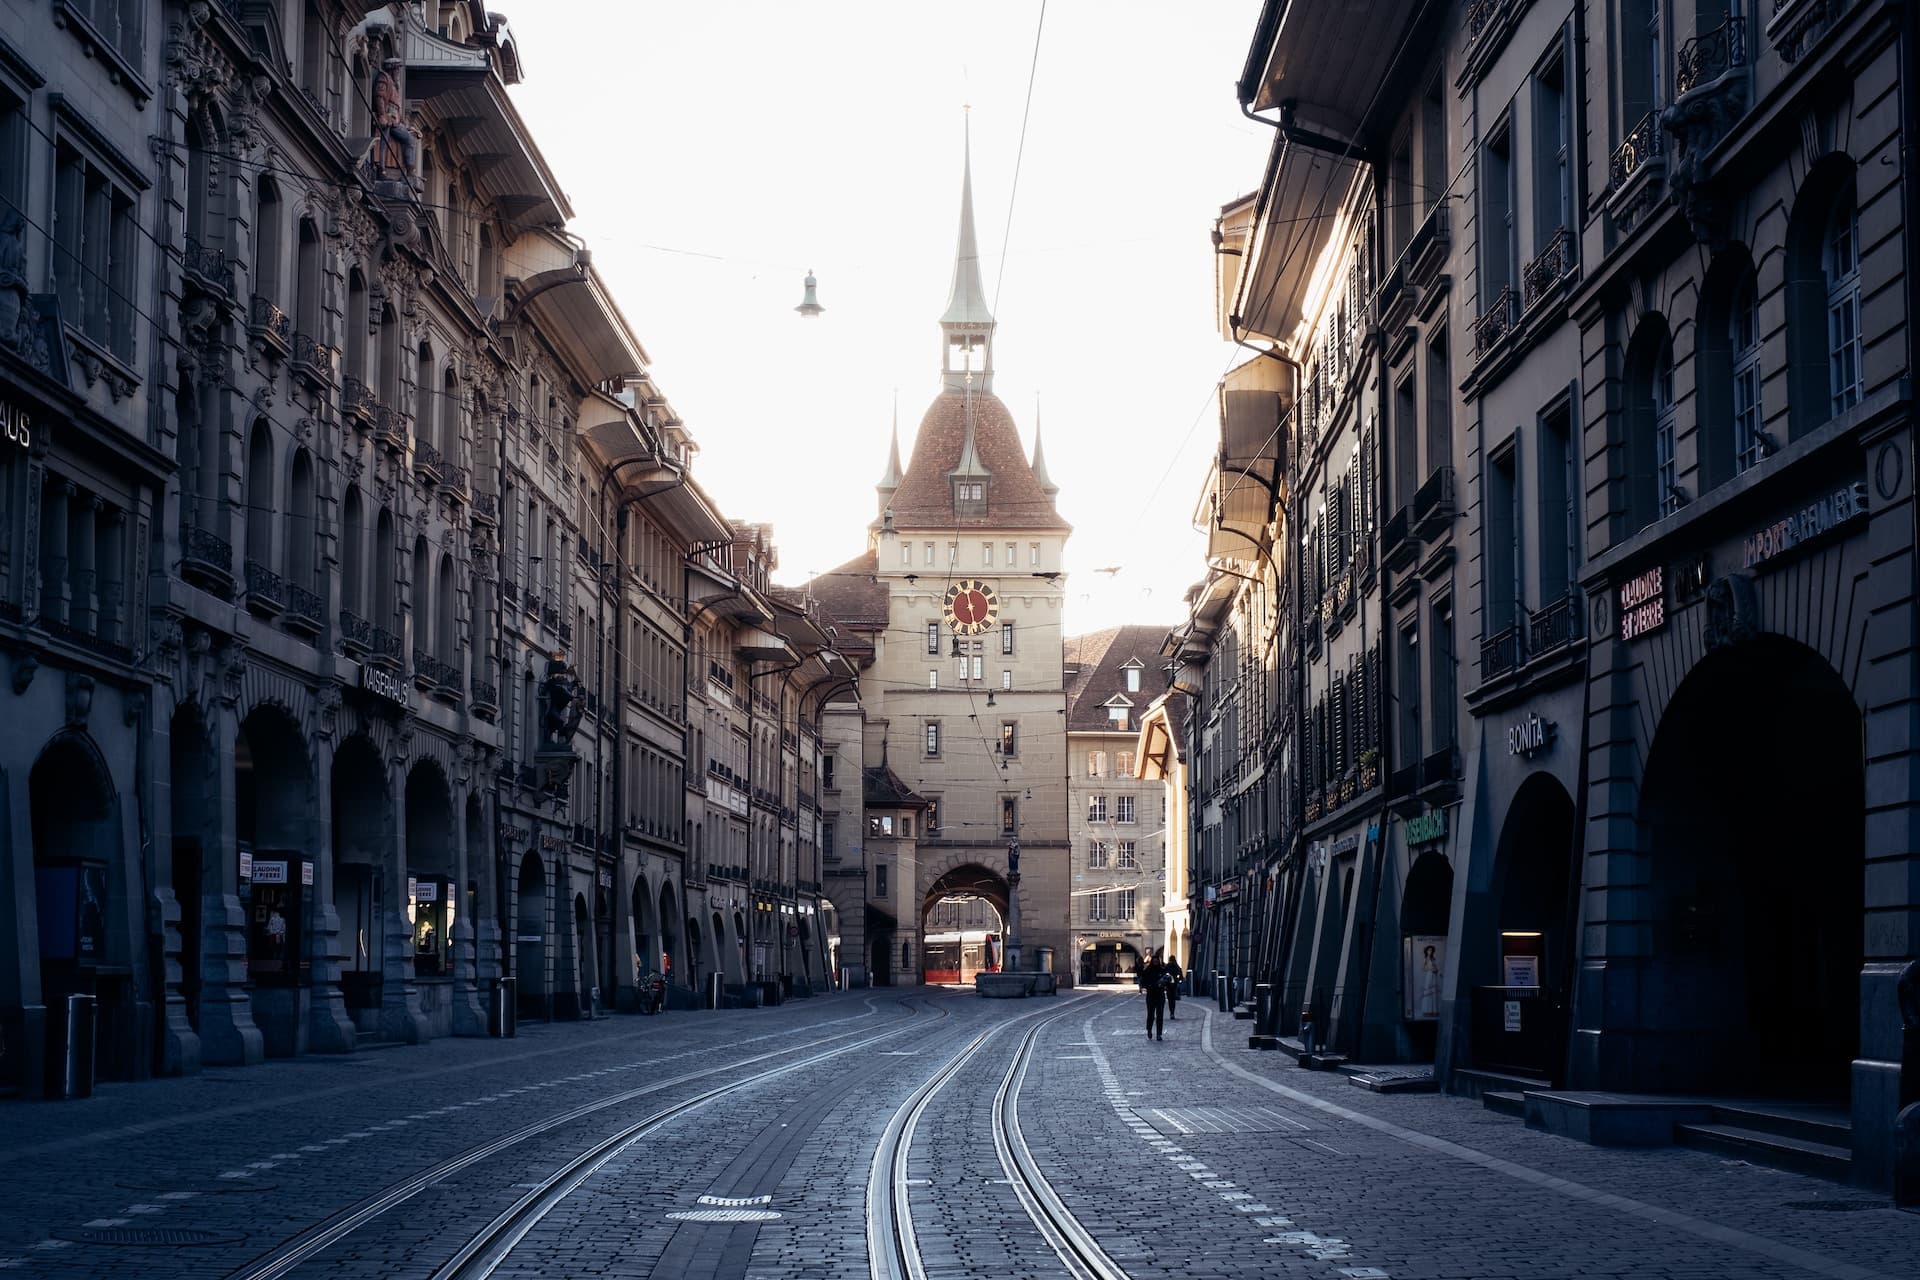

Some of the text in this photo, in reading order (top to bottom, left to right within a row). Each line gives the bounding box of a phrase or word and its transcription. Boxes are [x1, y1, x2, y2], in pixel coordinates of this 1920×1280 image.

[1743, 520, 1786, 569] IMPORT
[1621, 598, 1664, 641] ET PIERRE
[364, 665, 408, 704] KAISERHAUS
[1509, 713, 1543, 758] BONITA
